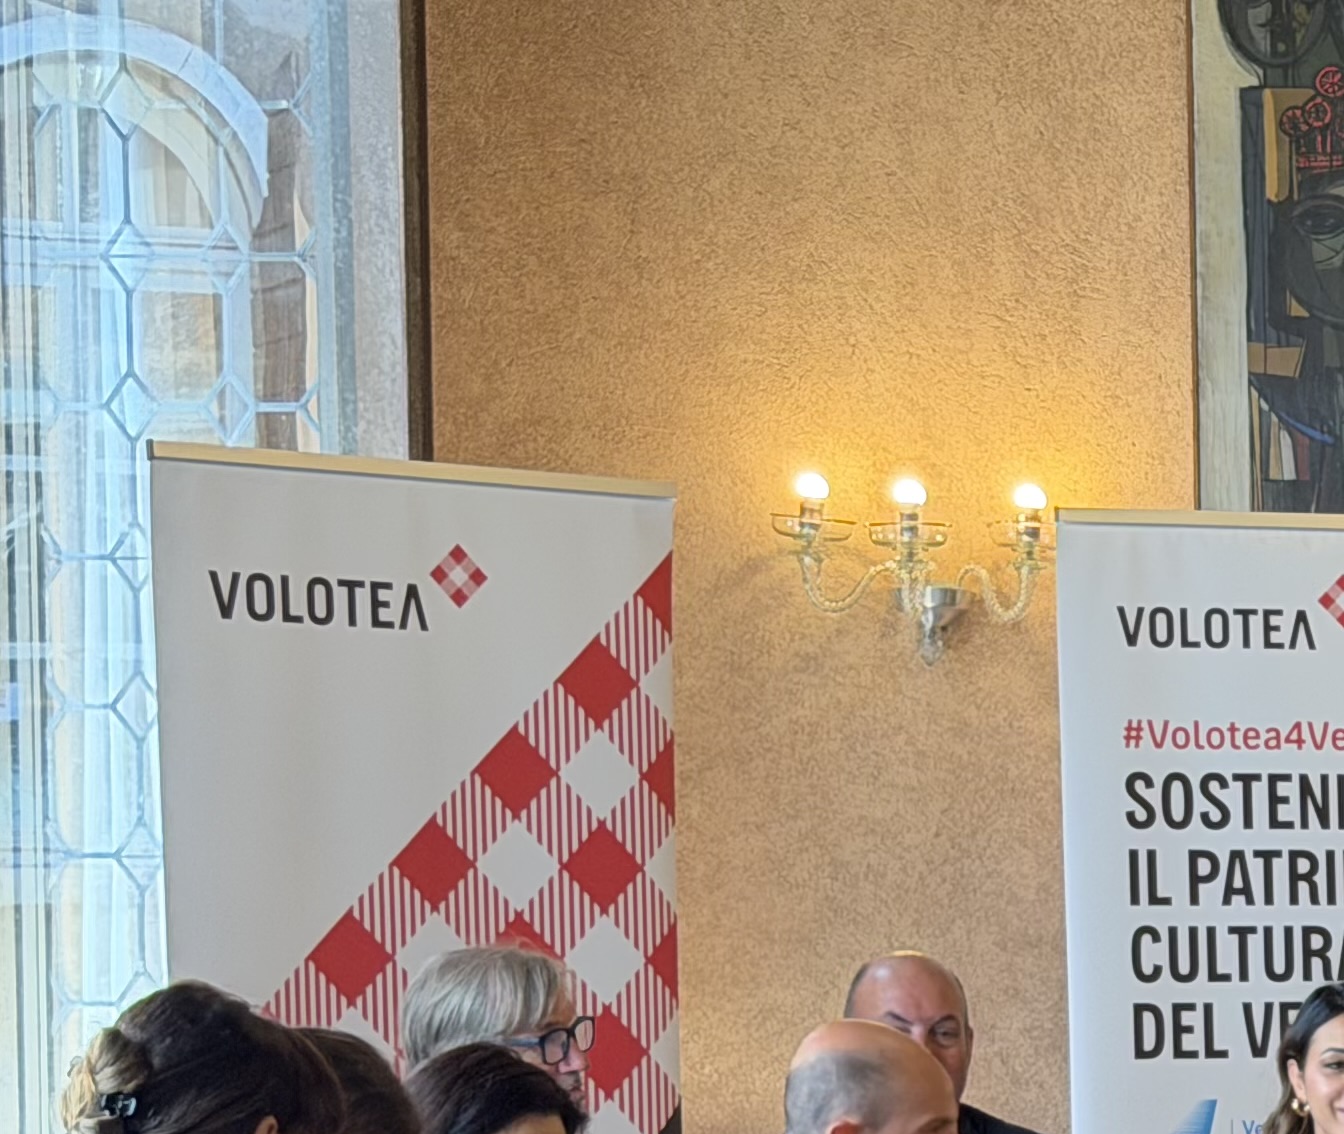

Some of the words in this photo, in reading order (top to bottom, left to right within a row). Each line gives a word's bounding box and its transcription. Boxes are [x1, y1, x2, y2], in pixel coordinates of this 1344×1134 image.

[208, 569, 429, 632] VOLOTEA
[1117, 605, 1317, 650] VOLOTEA
[1127, 848, 1172, 907] IL
[1132, 1001, 1230, 1061] DEL
